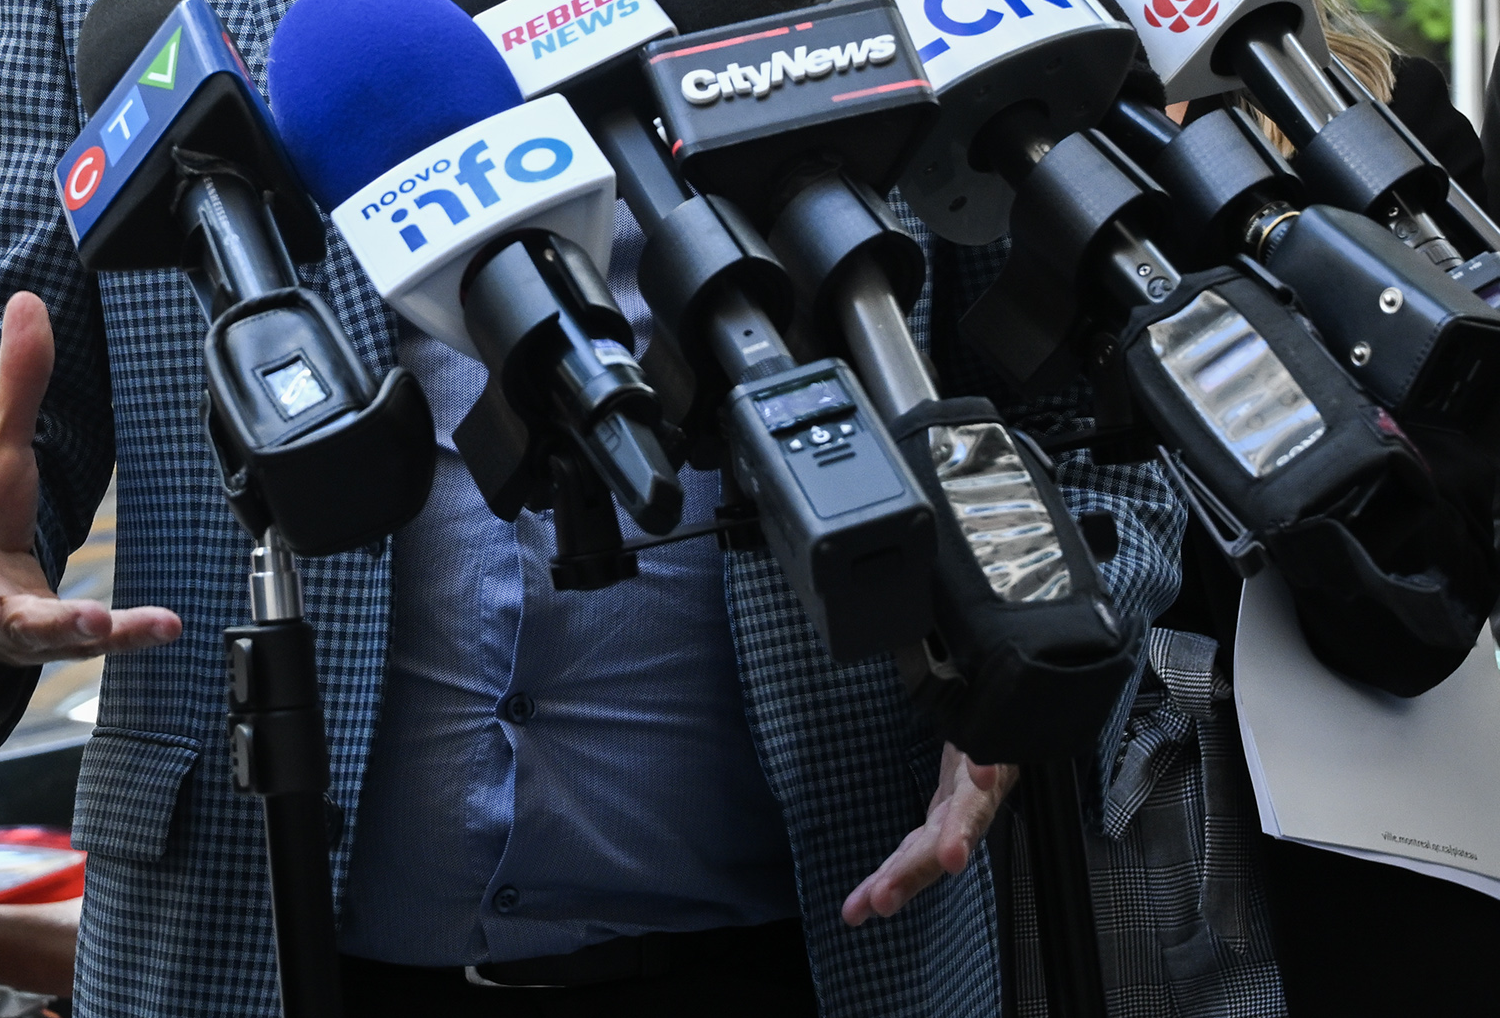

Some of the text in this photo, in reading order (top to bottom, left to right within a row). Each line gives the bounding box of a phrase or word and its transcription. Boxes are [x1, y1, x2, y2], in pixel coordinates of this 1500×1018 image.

[681, 33, 896, 105] CityNews
[67, 34, 180, 202] CTV
[360, 158, 452, 220] noovo
[390, 136, 574, 253] info
